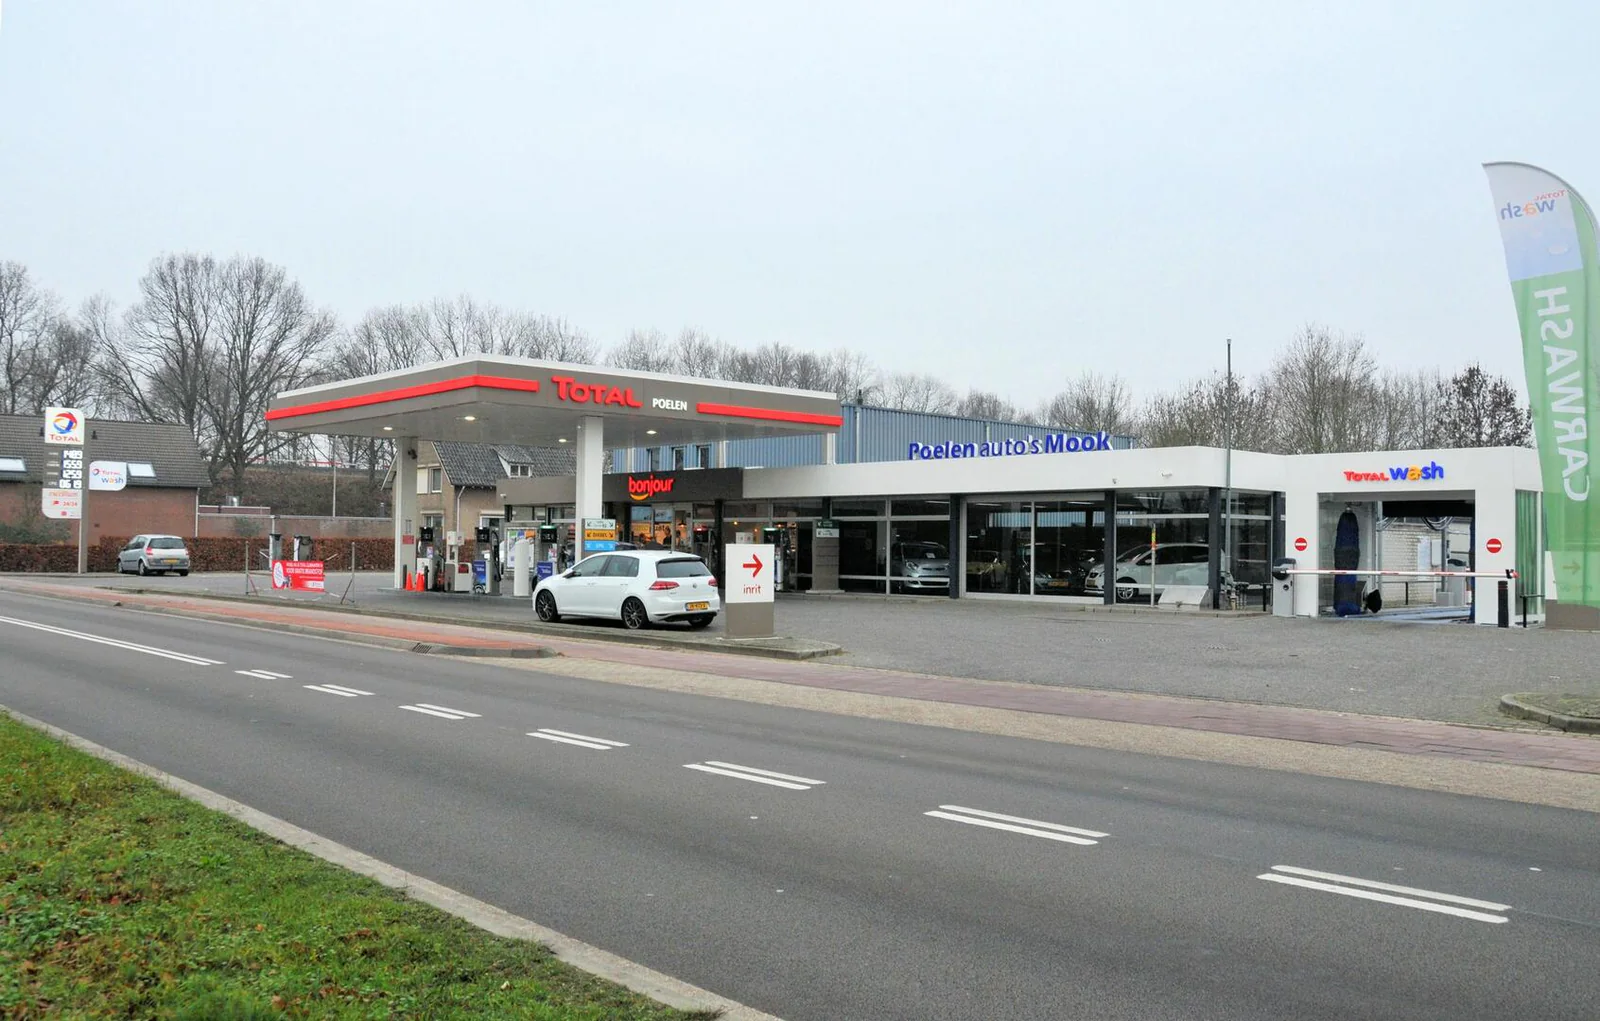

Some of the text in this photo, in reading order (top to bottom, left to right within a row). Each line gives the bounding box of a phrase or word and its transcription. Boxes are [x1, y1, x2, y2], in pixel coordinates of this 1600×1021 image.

[551, 375, 643, 408] TOTAL
[652, 398, 687, 411] POELEN
[49, 434, 81, 442] TOTAL
[908, 431, 1113, 461] Poelen auto's Mook
[101, 476, 124, 484] wash
[1343, 461, 1444, 482] TOTAL wash
[628, 473, 674, 497] bonjour
[743, 583, 761, 594] inrit
